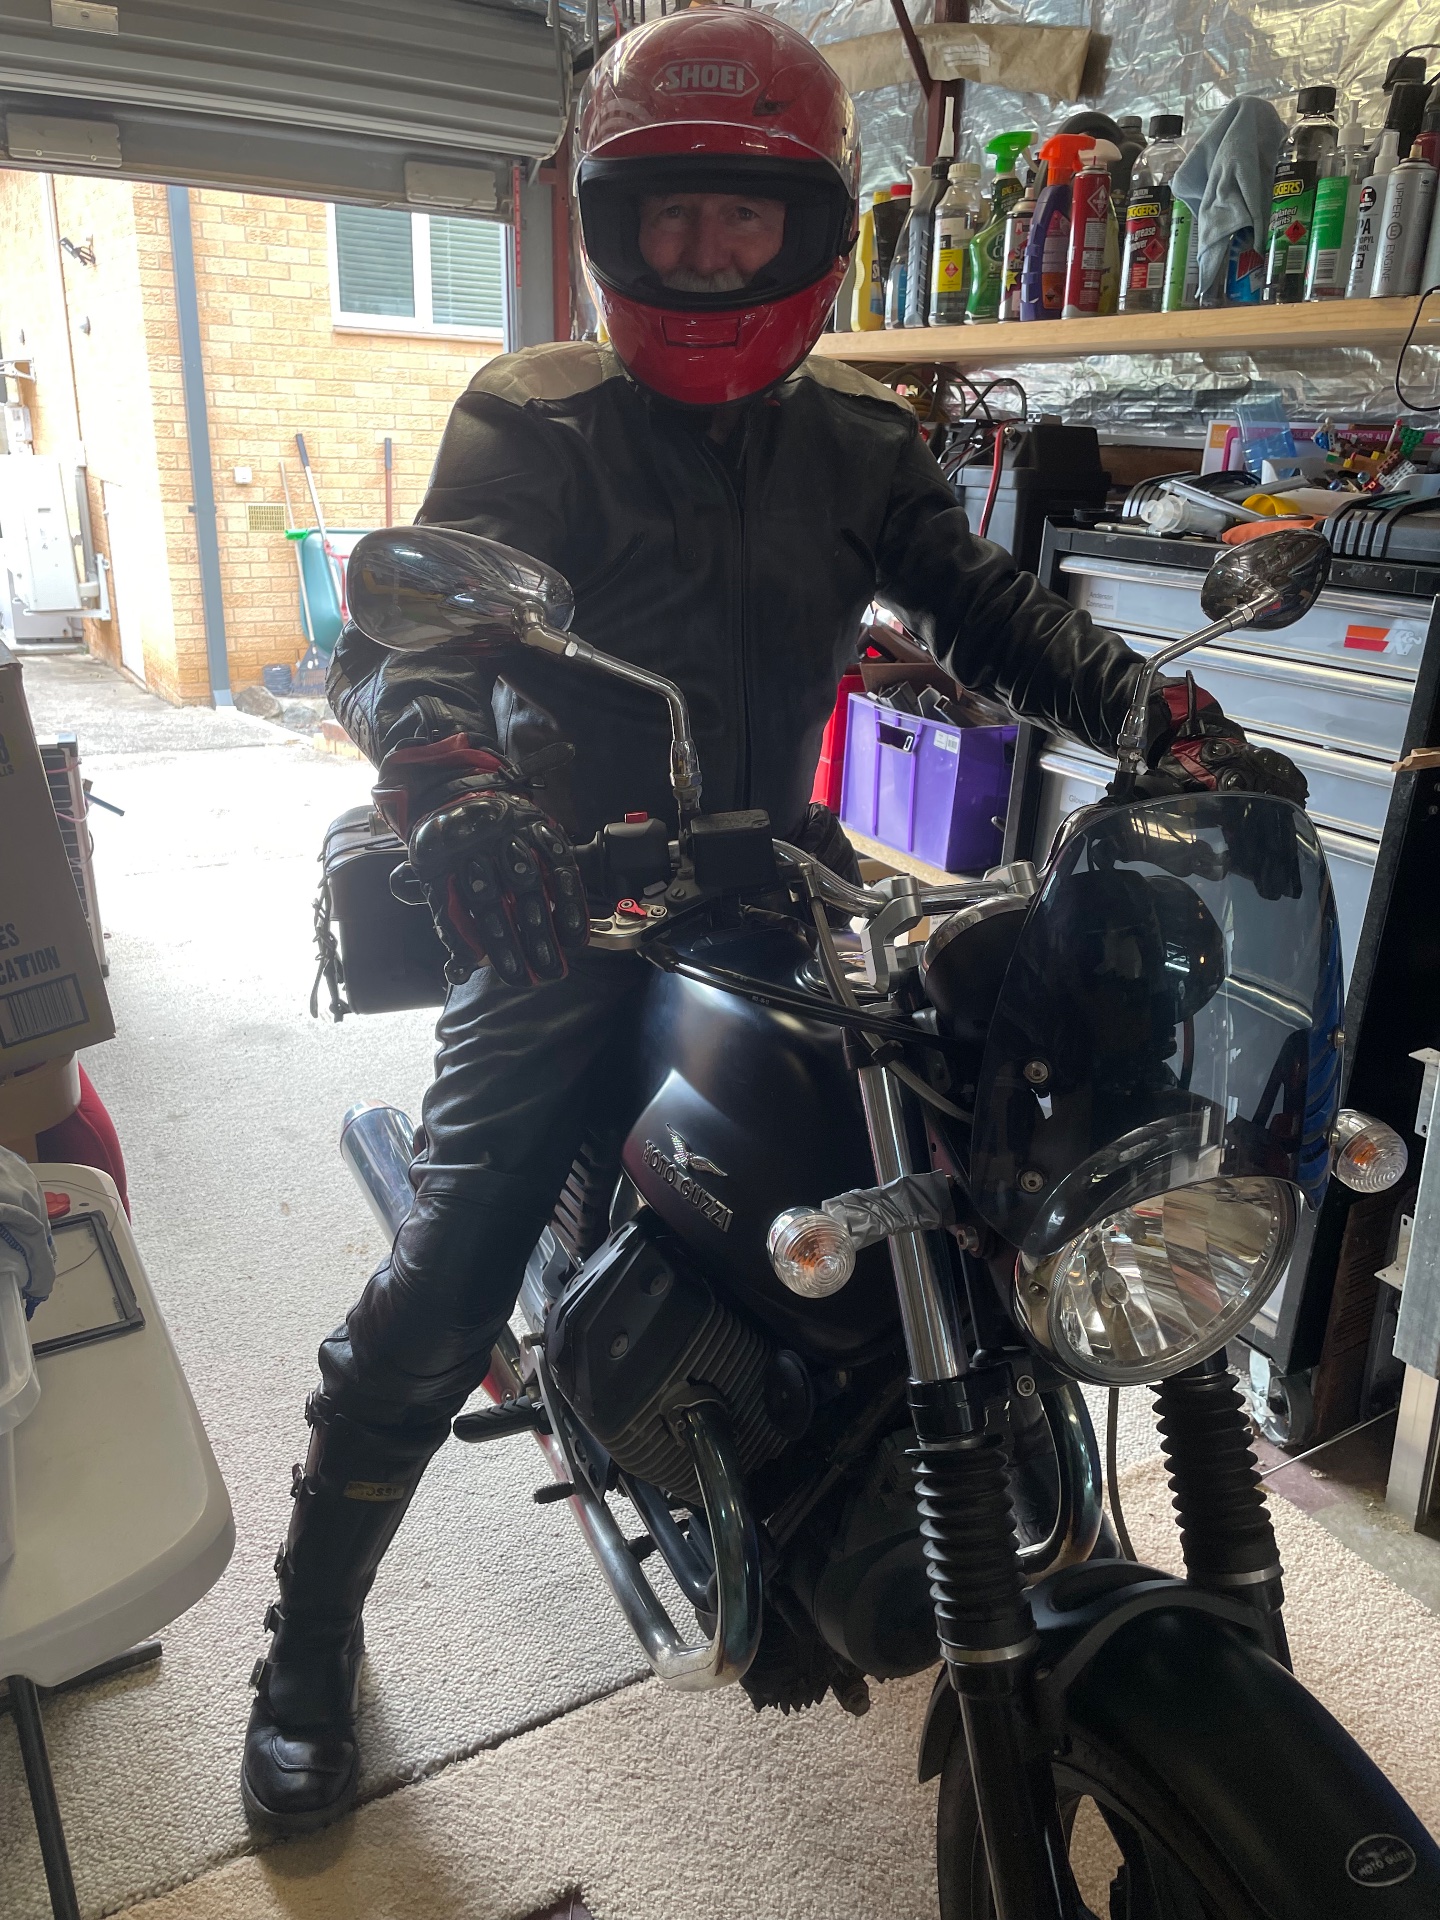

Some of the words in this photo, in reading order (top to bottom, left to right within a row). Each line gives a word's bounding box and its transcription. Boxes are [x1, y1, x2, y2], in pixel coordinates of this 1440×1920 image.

[665, 64, 745, 91] SHOEI
[1391, 182, 1405, 219] UPPER
[1381, 244, 1395, 282] ENGINE
[643, 1139, 677, 1186] MOTO
[680, 1176, 734, 1233] GUZZI
